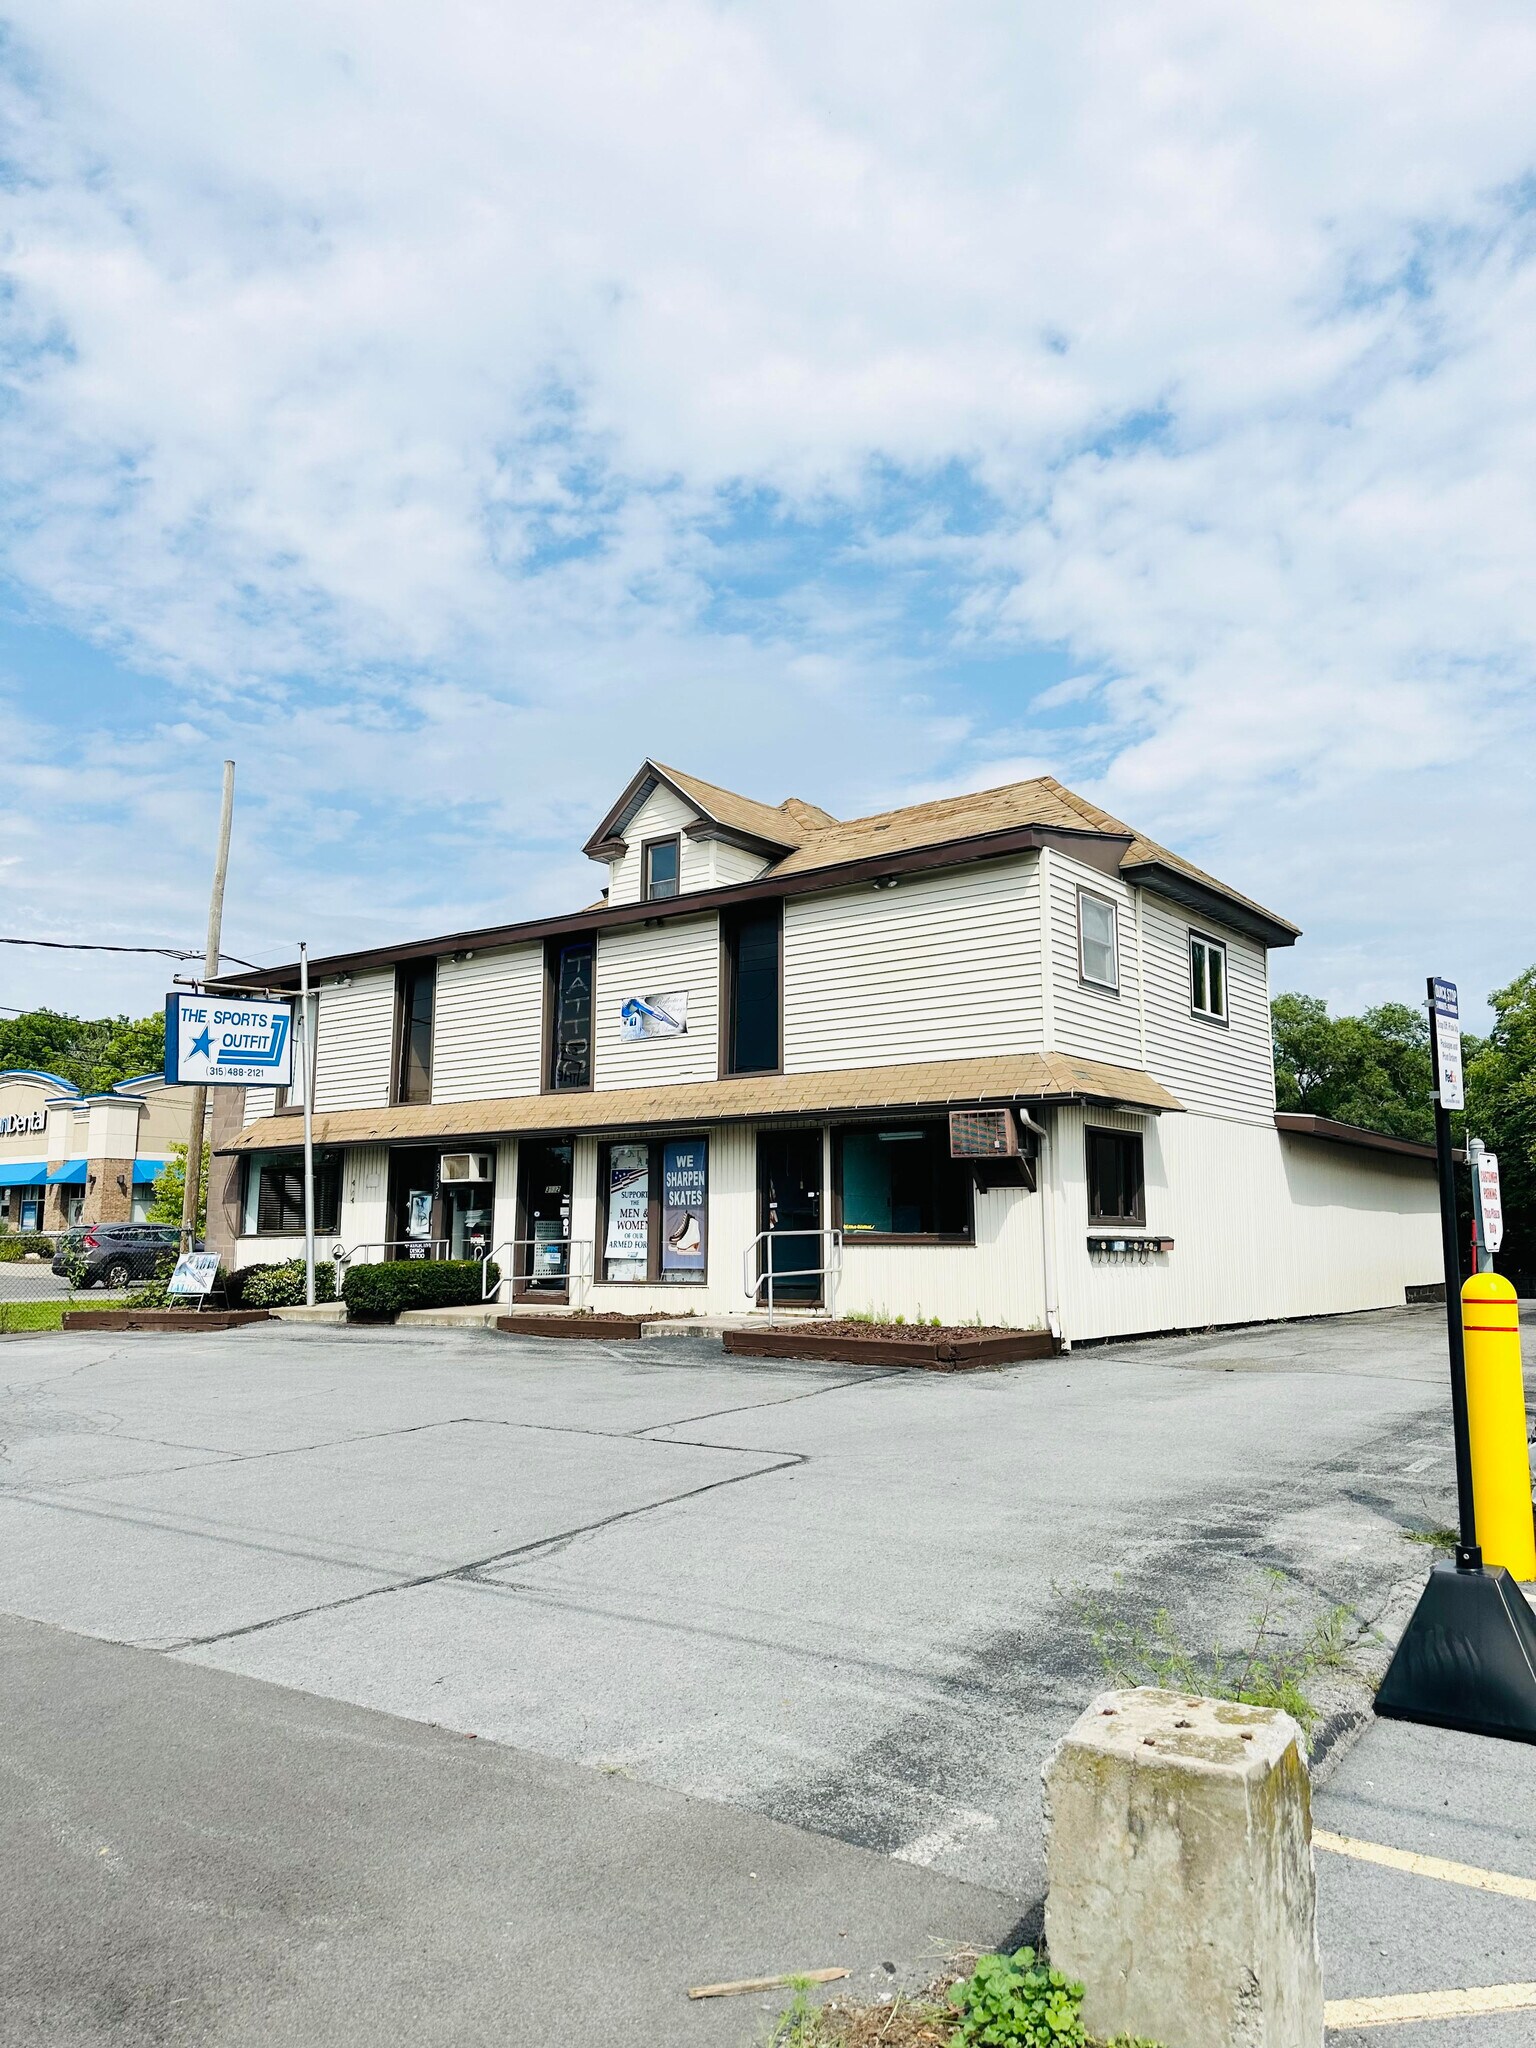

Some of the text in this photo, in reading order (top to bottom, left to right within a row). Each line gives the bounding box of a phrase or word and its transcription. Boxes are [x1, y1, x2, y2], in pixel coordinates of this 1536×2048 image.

[1446, 988, 1458, 1003] STOP
[181, 1008, 268, 1027] THE SPORTS
[222, 1033, 270, 1049] OUTFIT
[205, 1066, 264, 1078] (315)488-2121
[1444, 1069, 1457, 1084] FedEx
[676, 1155, 694, 1168] WE
[666, 1170, 705, 1187] SHARPEN
[668, 1190, 703, 1206] SKATES
[620, 1208, 640, 1218] MEN
[609, 1240, 633, 1248] ARMED
